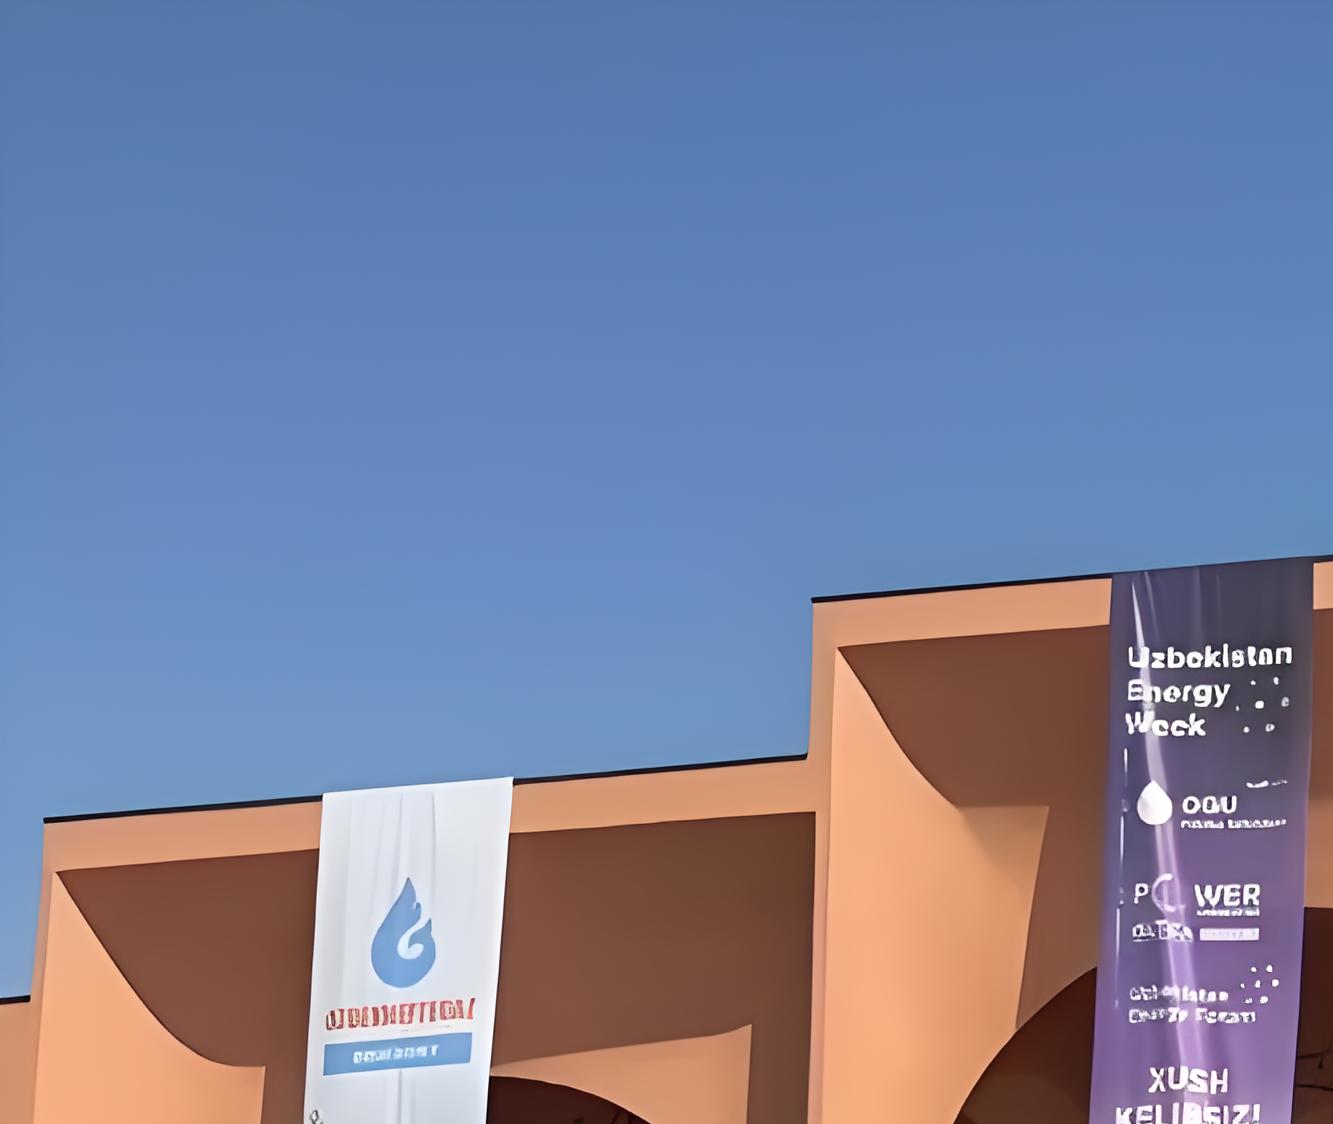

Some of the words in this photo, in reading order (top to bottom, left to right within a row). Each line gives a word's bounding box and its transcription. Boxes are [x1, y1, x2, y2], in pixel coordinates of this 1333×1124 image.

[1128, 643, 1293, 669] Uzbekistan
[1127, 679, 1231, 708] Energy
[1125, 713, 1206, 737] Week
[1148, 1066, 1229, 1095] XUSH
